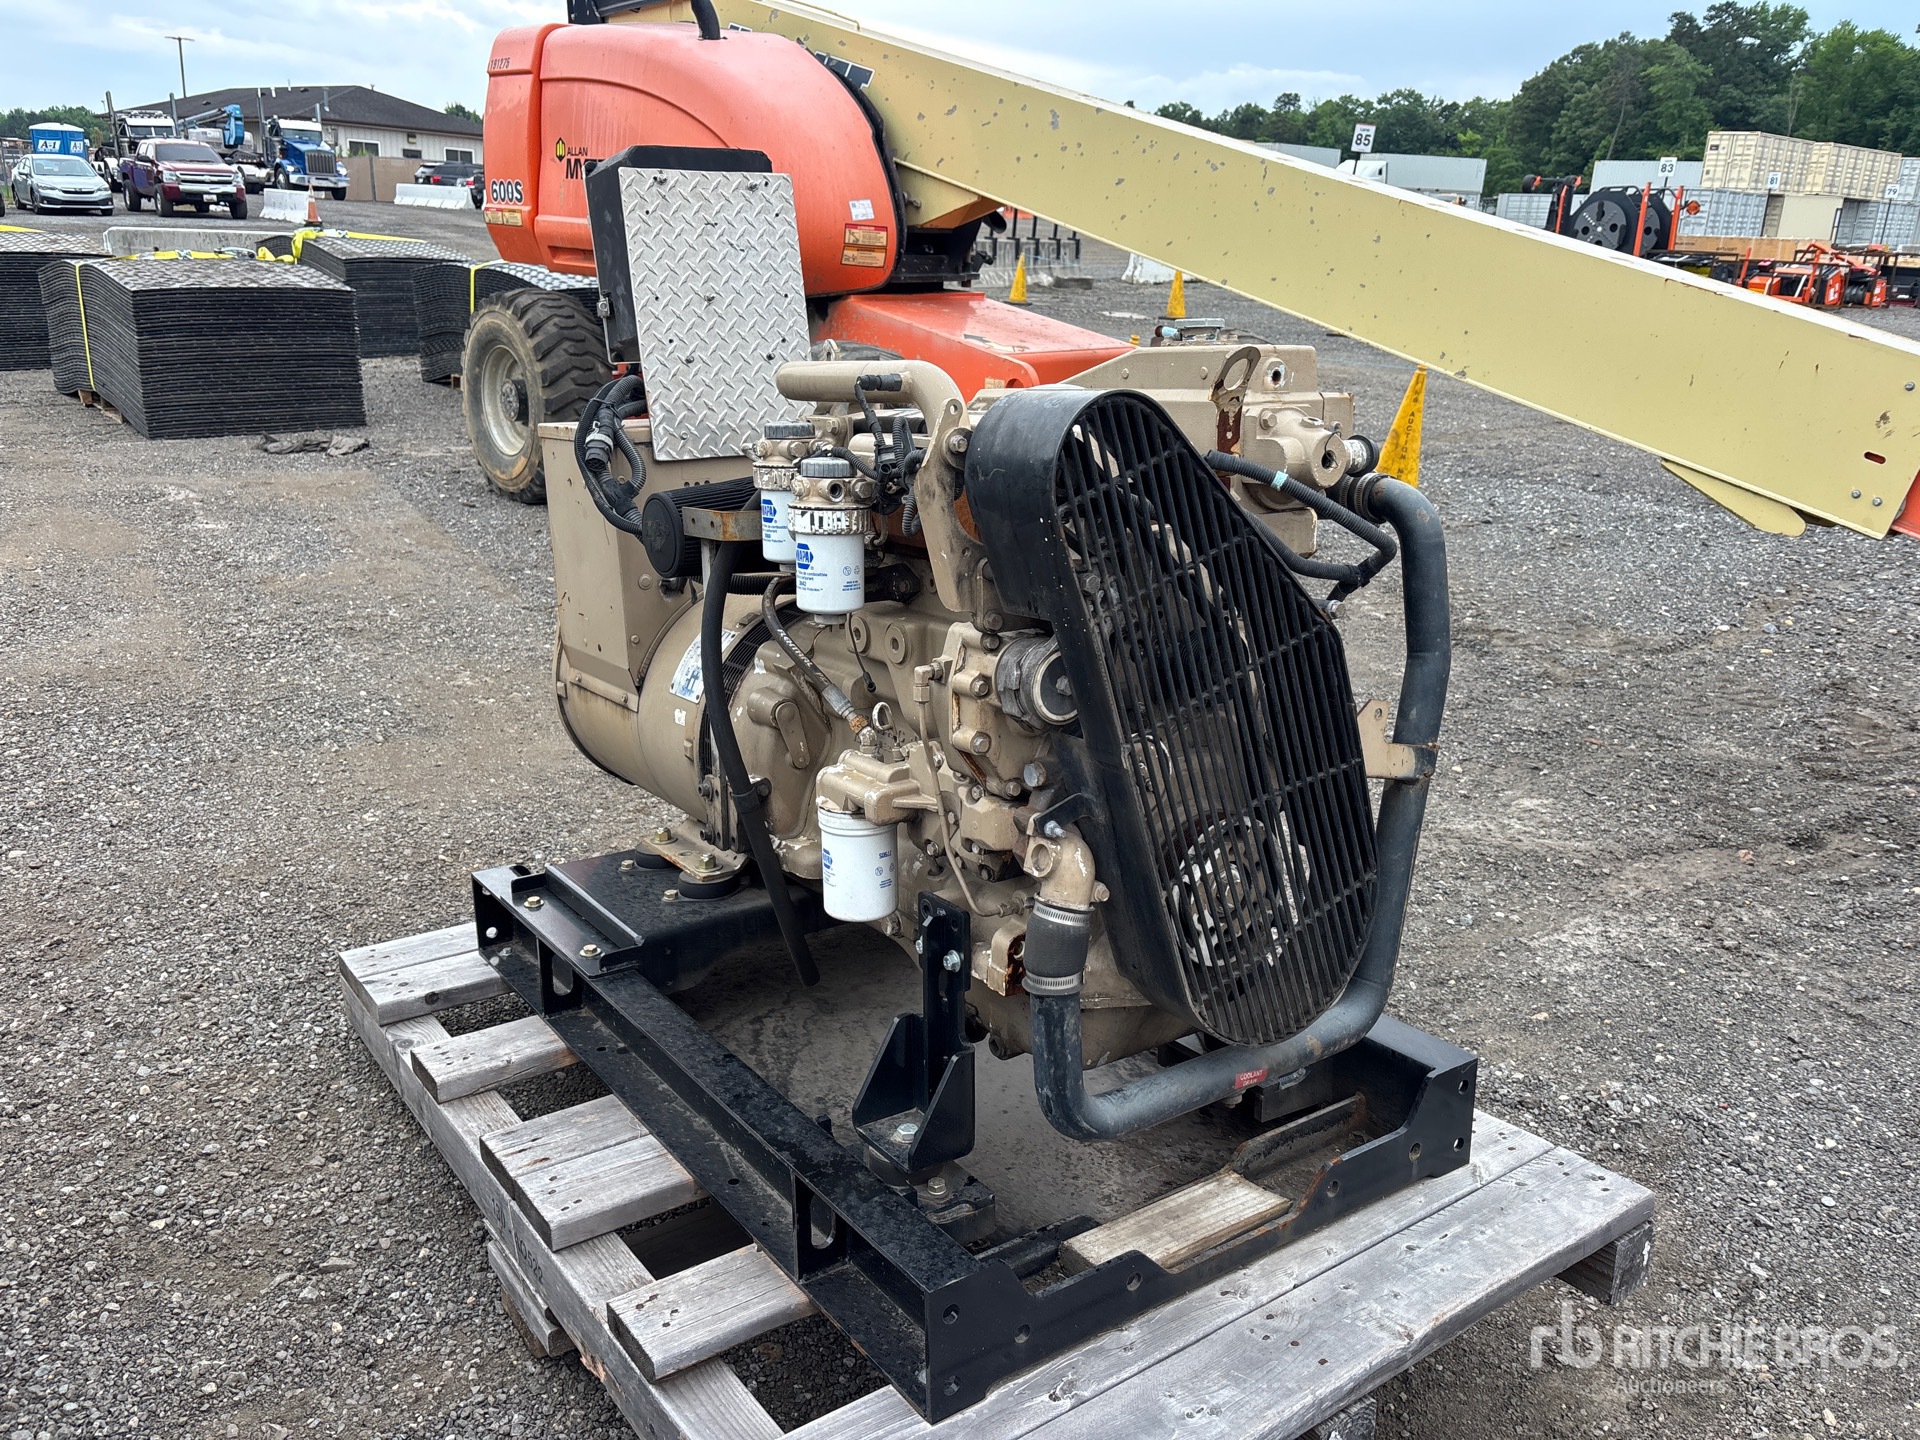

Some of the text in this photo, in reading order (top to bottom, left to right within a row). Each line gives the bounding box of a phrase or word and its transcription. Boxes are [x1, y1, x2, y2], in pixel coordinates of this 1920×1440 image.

[40, 140, 57, 149] A-1
[1355, 133, 1372, 147] 85
[567, 146, 588, 157] ALLAN
[1660, 163, 1675, 173] 83
[1769, 176, 1779, 185] 81
[490, 179, 524, 204] 600S
[1887, 188, 1898, 196] 79
[1399, 411, 1416, 461] AUCTION
[1240, 1069, 1263, 1081] COOLANT
